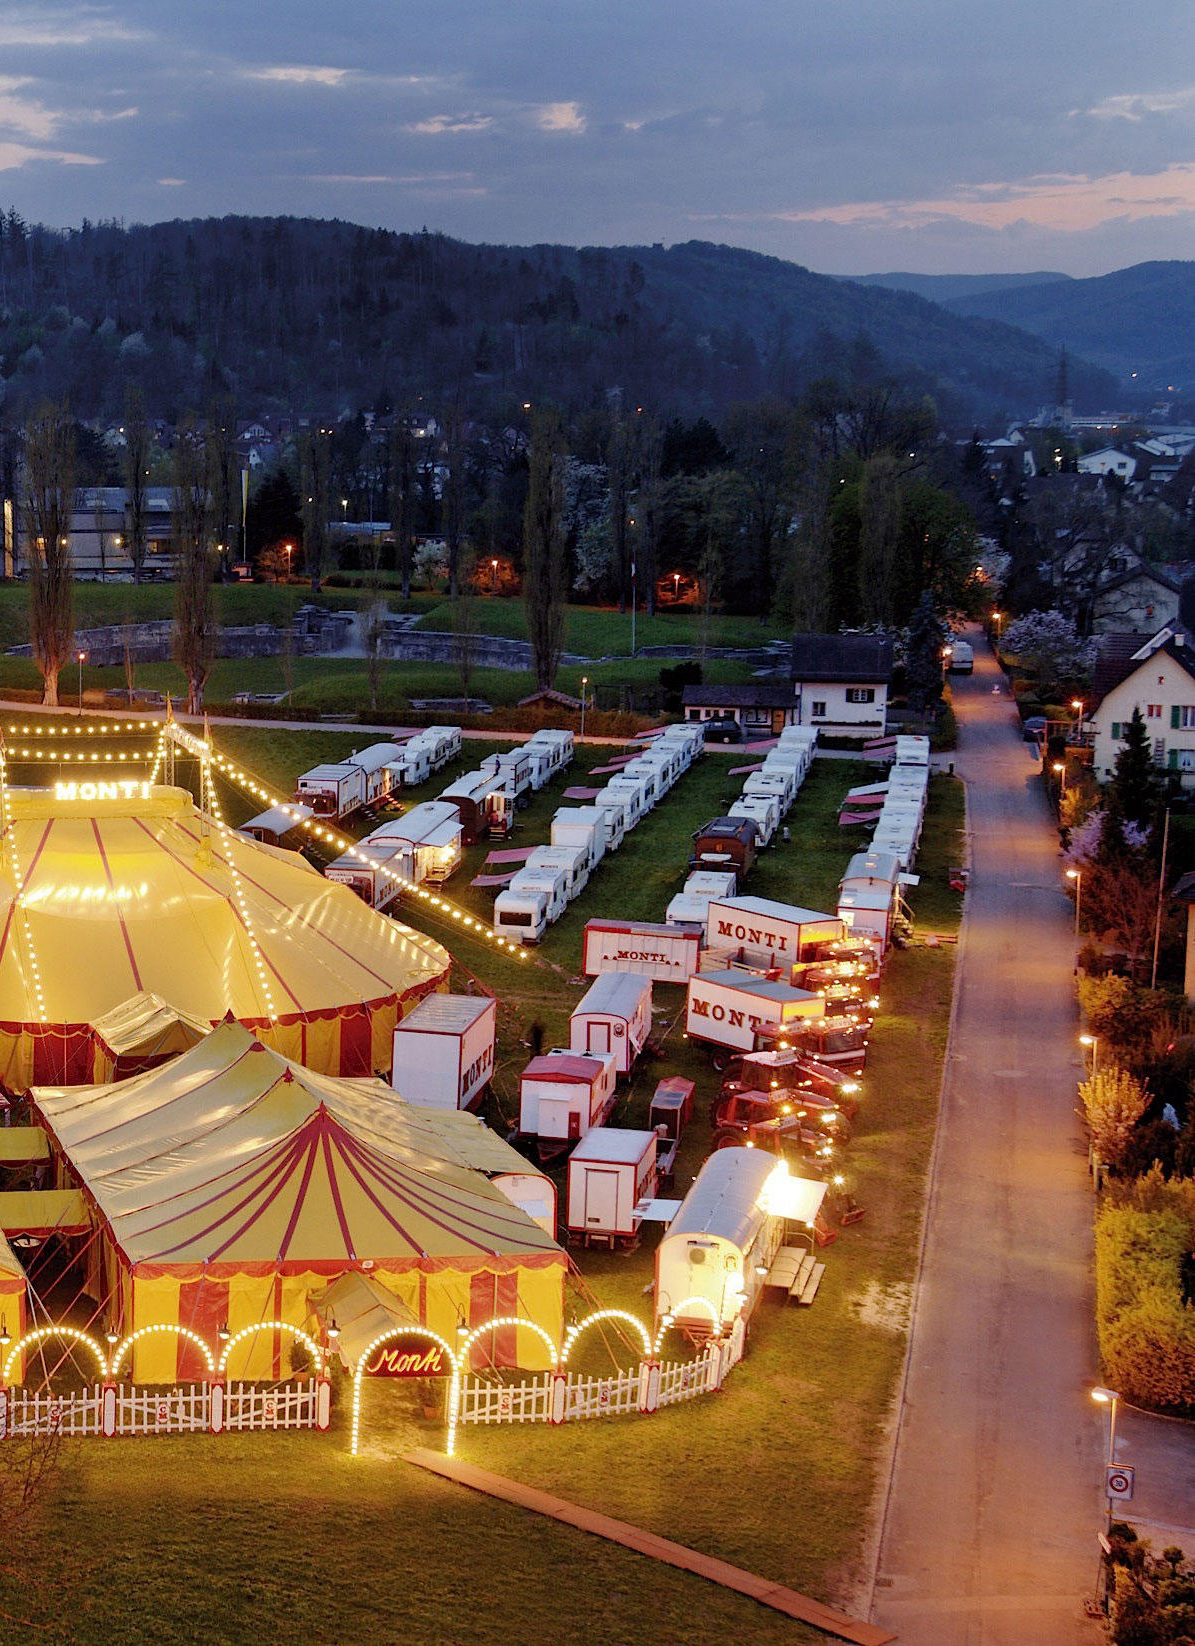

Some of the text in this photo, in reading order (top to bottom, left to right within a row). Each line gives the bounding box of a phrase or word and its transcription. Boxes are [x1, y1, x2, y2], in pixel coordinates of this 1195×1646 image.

[55, 781, 150, 800] MONTI
[718, 920, 787, 951] MONTI
[617, 945, 666, 962] MONTI
[692, 998, 775, 1032] MONT
[462, 1044, 492, 1097] MONTI
[367, 1346, 444, 1372] Monti
